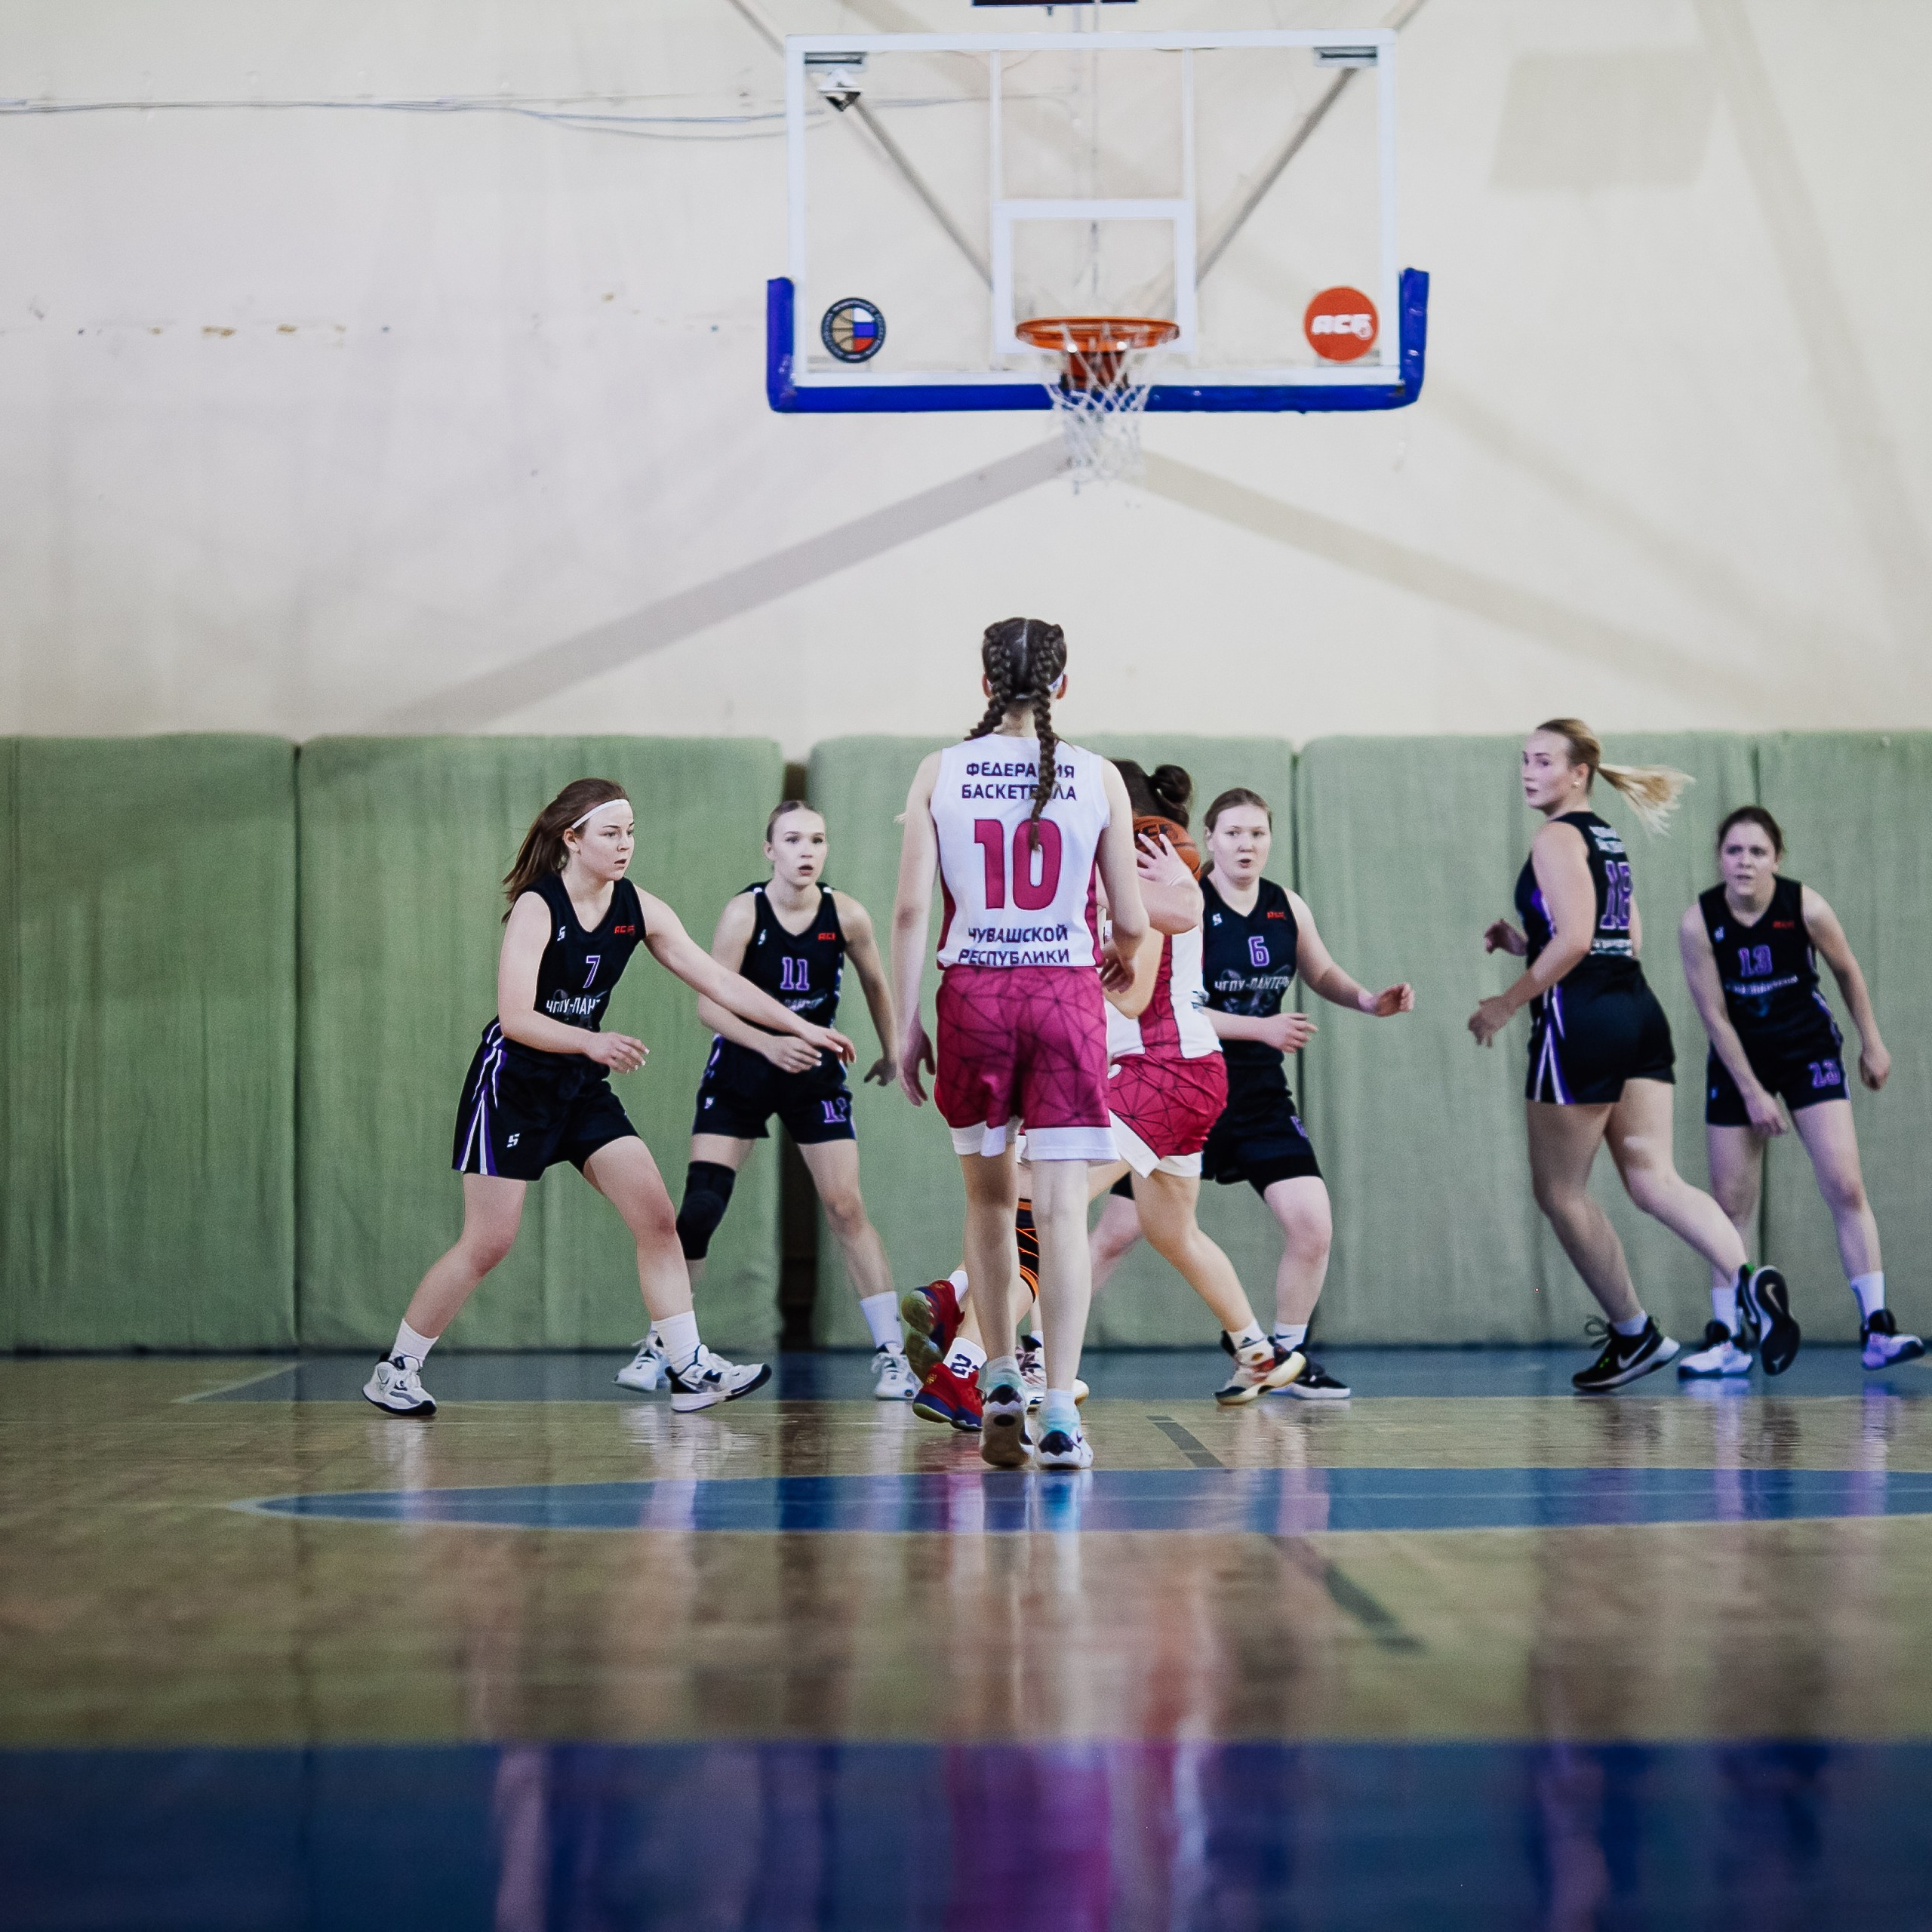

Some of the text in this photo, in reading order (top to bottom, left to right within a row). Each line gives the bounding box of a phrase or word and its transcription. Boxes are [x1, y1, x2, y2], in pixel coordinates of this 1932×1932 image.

[966, 761, 1075, 778] ФЕДЕРАИЯ
[961, 784, 1077, 800] БАСКЕТБЛА
[974, 818, 1063, 911] 10
[968, 924, 1068, 943] ЧУВАШСКОЙ
[958, 949, 1069, 966] РЕСПУБЛИКИ
[1248, 935, 1270, 967] 6
[583, 955, 601, 989] 7
[780, 956, 810, 991] 11
